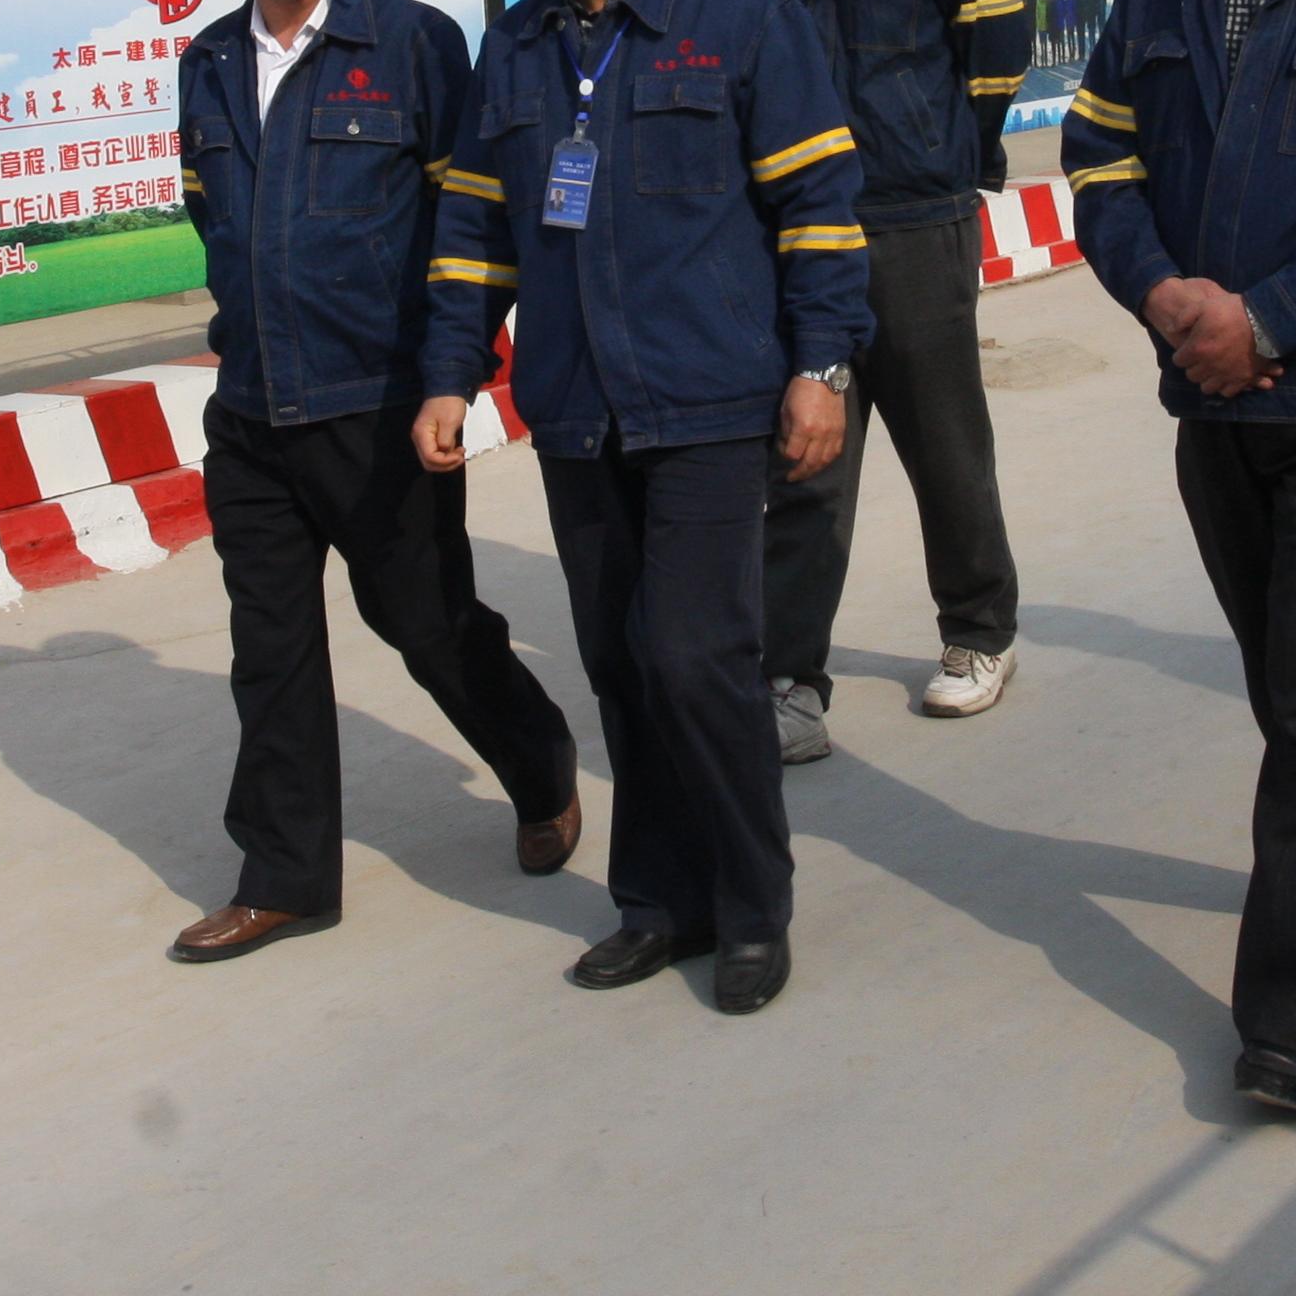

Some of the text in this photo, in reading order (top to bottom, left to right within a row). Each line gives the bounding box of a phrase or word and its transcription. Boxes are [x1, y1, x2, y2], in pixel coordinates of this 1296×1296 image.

[52, 36, 193, 70] 太原一建集团
